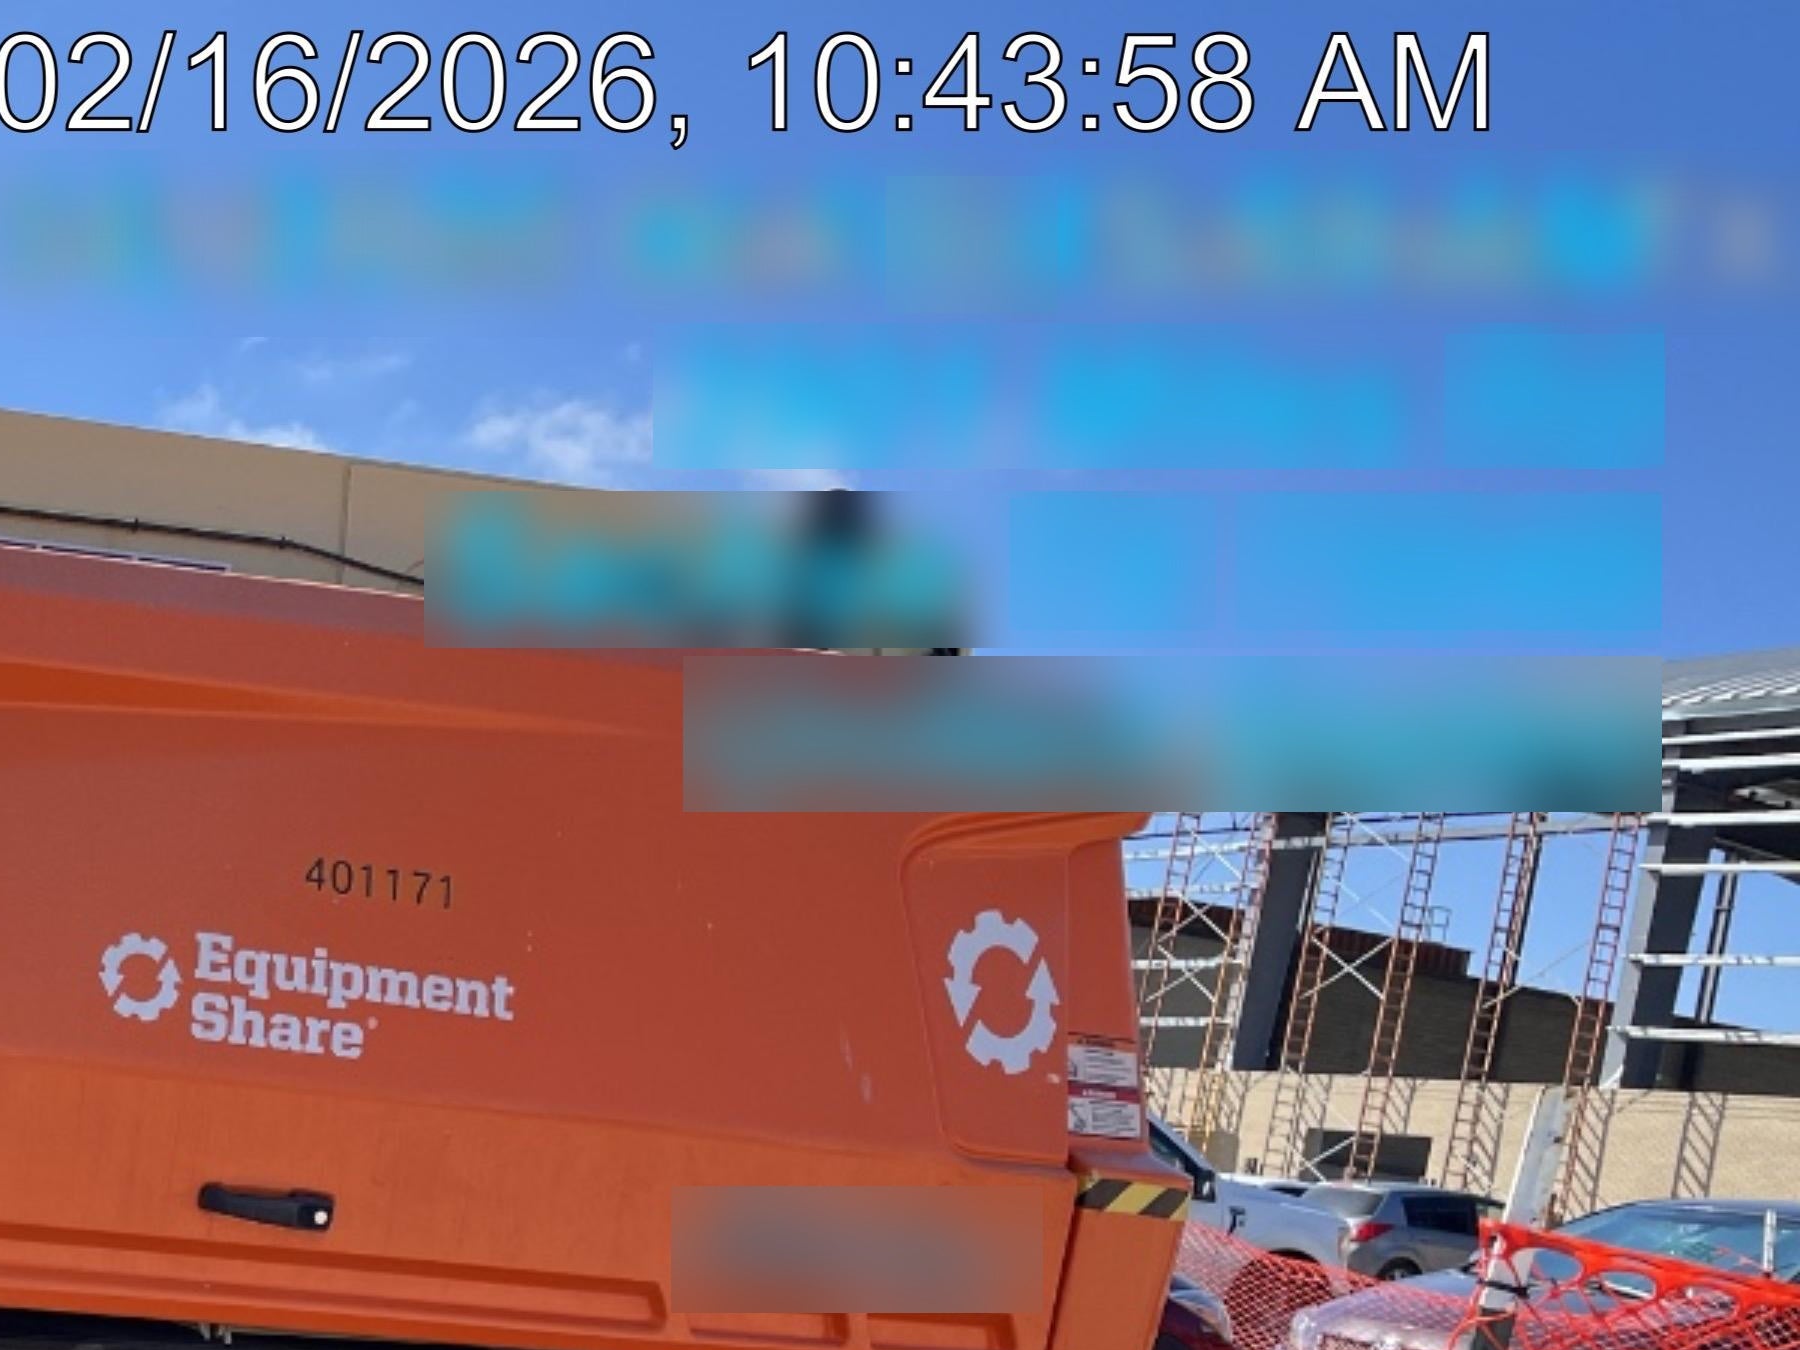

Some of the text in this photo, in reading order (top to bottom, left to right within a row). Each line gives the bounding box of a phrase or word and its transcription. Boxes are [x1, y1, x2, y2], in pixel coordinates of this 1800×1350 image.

[305, 857, 453, 909] 401171
[194, 932, 515, 1021] Equipment
[190, 992, 365, 1059] Share
